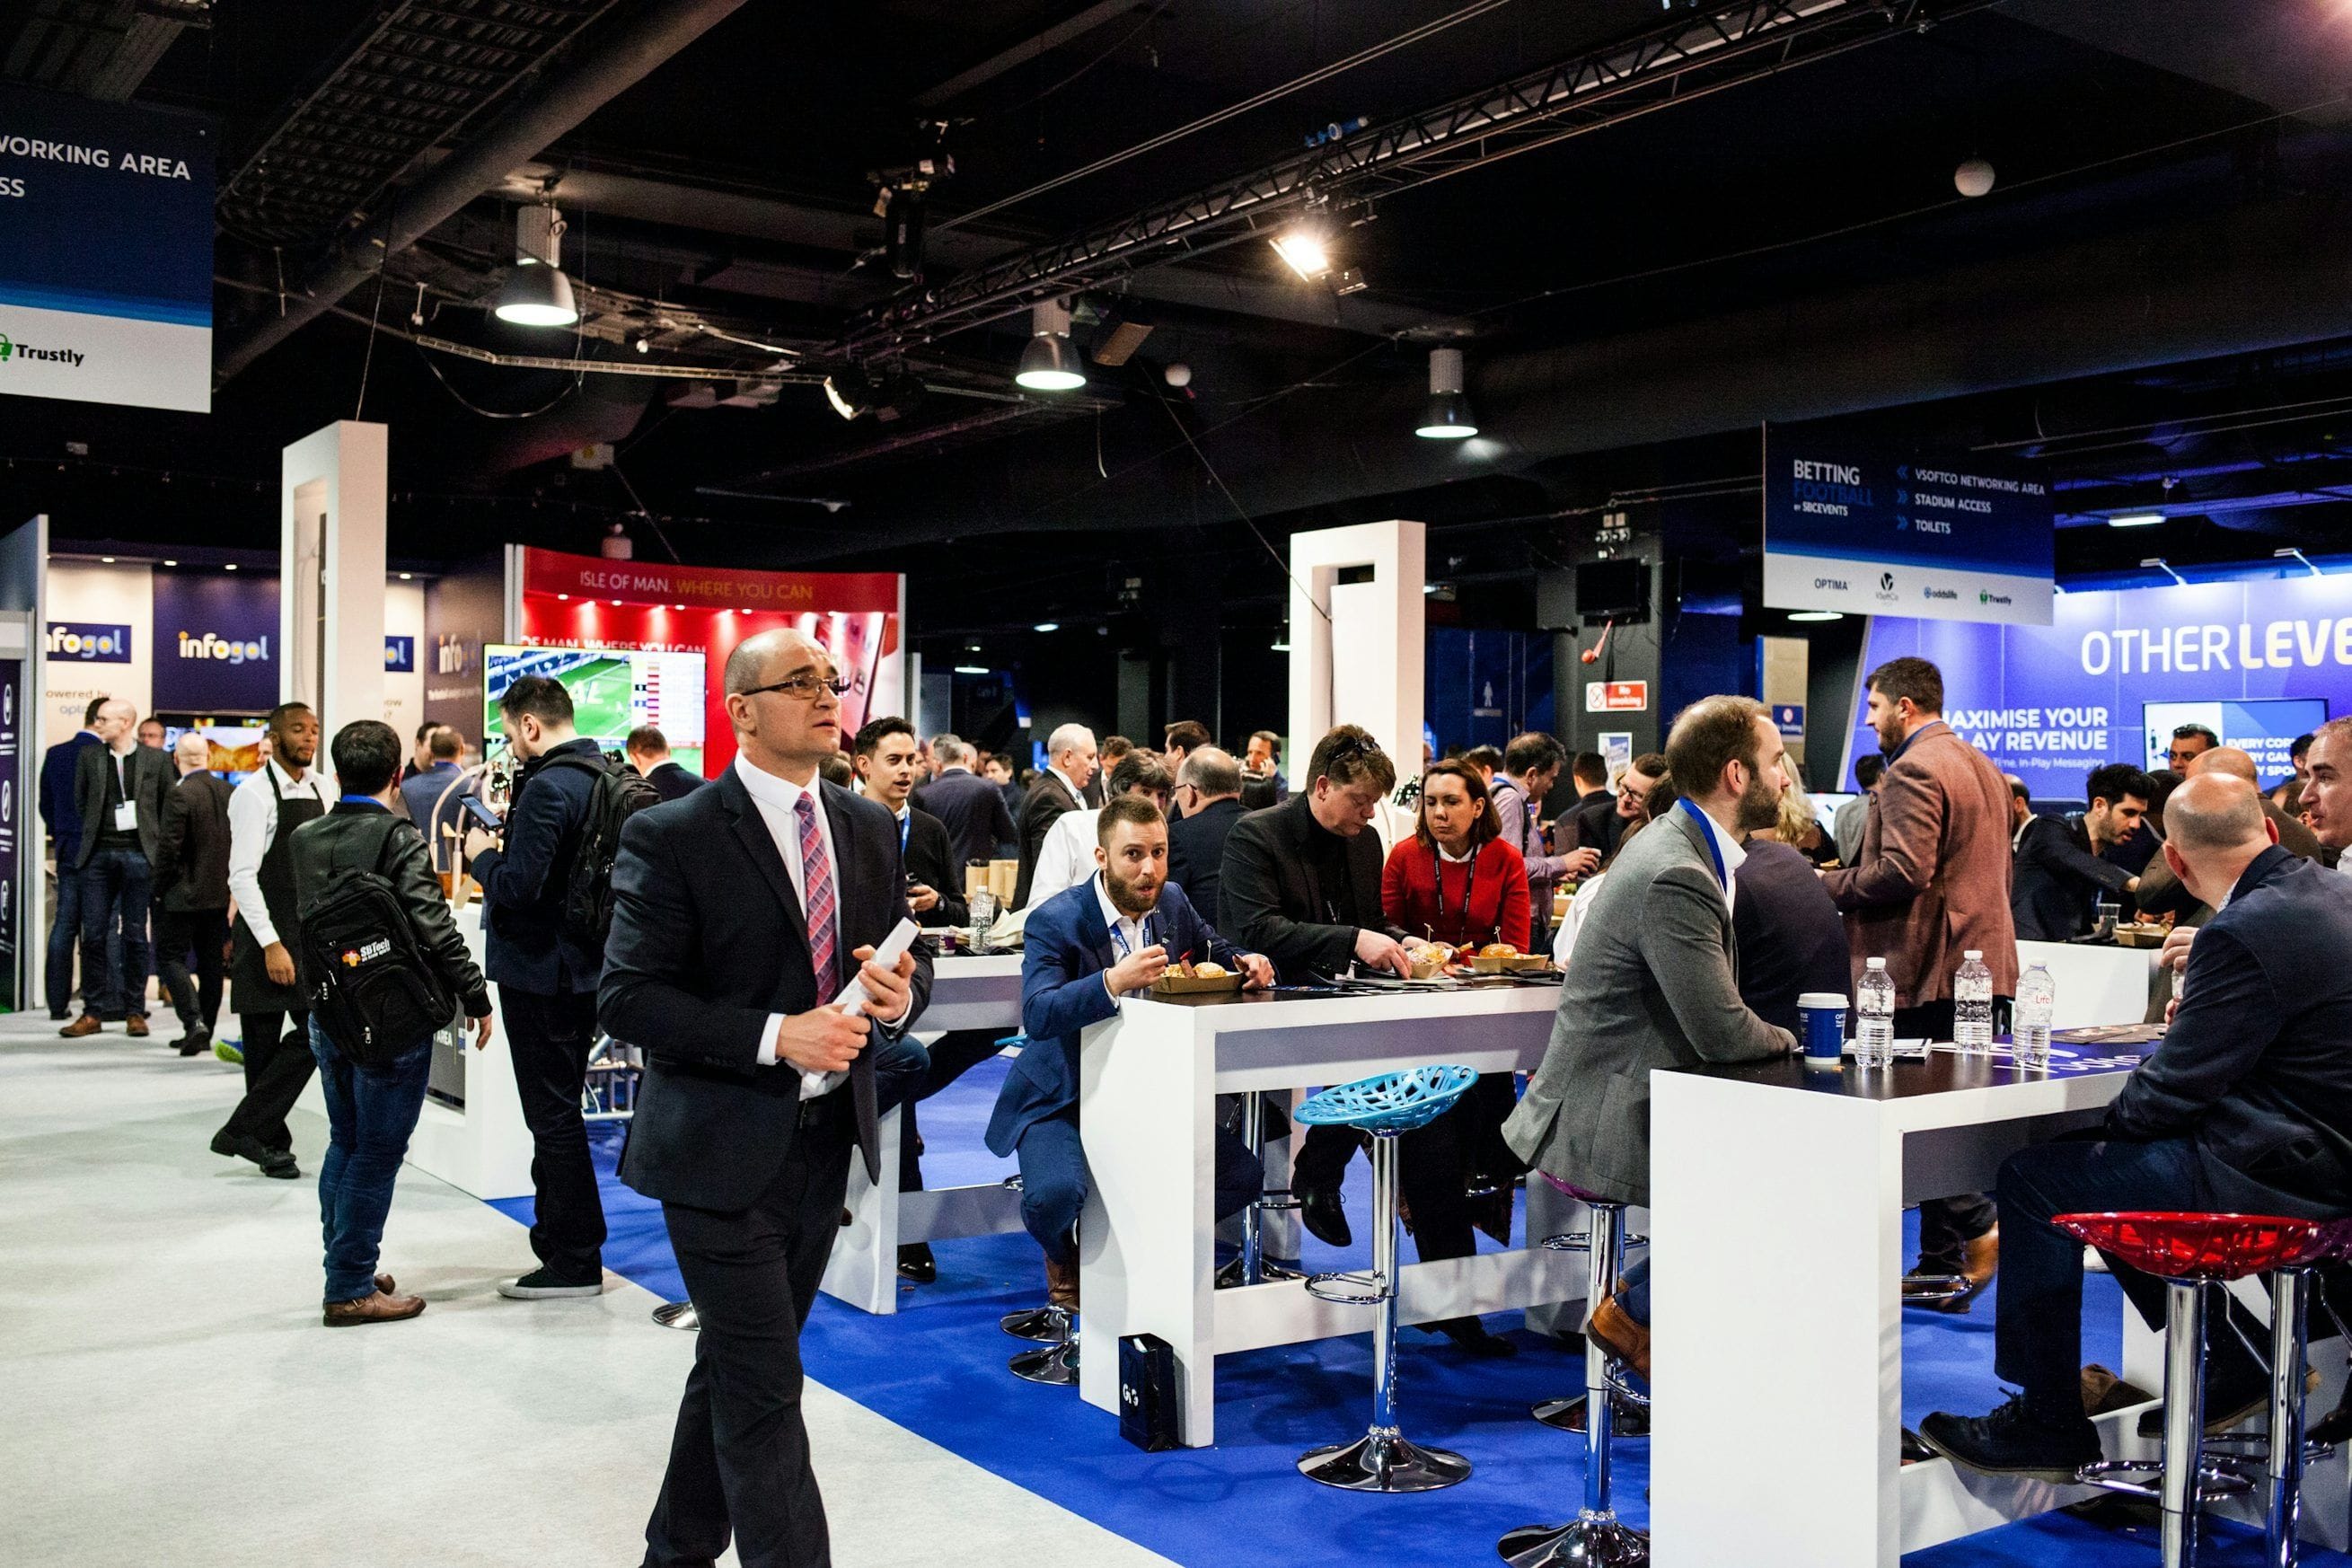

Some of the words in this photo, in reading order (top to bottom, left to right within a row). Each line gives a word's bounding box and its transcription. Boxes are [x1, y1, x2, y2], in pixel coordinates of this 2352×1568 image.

[119, 153, 191, 181] AREA
[15, 344, 84, 366] Trustly
[1793, 459, 1861, 486] BETTING
[1915, 468, 1959, 485] VSOFTCO
[1960, 474, 2020, 493] NETWORKING
[2021, 482, 2046, 496] AREA
[1793, 480, 1874, 507] FOOTBALL
[1915, 493, 1956, 509] STADIUM
[1958, 498, 1992, 513] ACCESS
[1915, 518, 1951, 534] TOILETS
[580, 569, 606, 590] ISLE
[609, 574, 630, 591] OF
[675, 579, 734, 595] WHERE
[736, 581, 771, 598] YOU
[776, 586, 814, 600] CAN
[1814, 577, 1848, 591] OPTIMA
[1988, 593, 2013, 605] Trustly
[179, 630, 269, 665] infogol
[2081, 623, 2233, 675] OTHER
[46, 689, 93, 700] owered
[2044, 706, 2108, 727] YOUR
[2004, 730, 2108, 752] REVENUE
